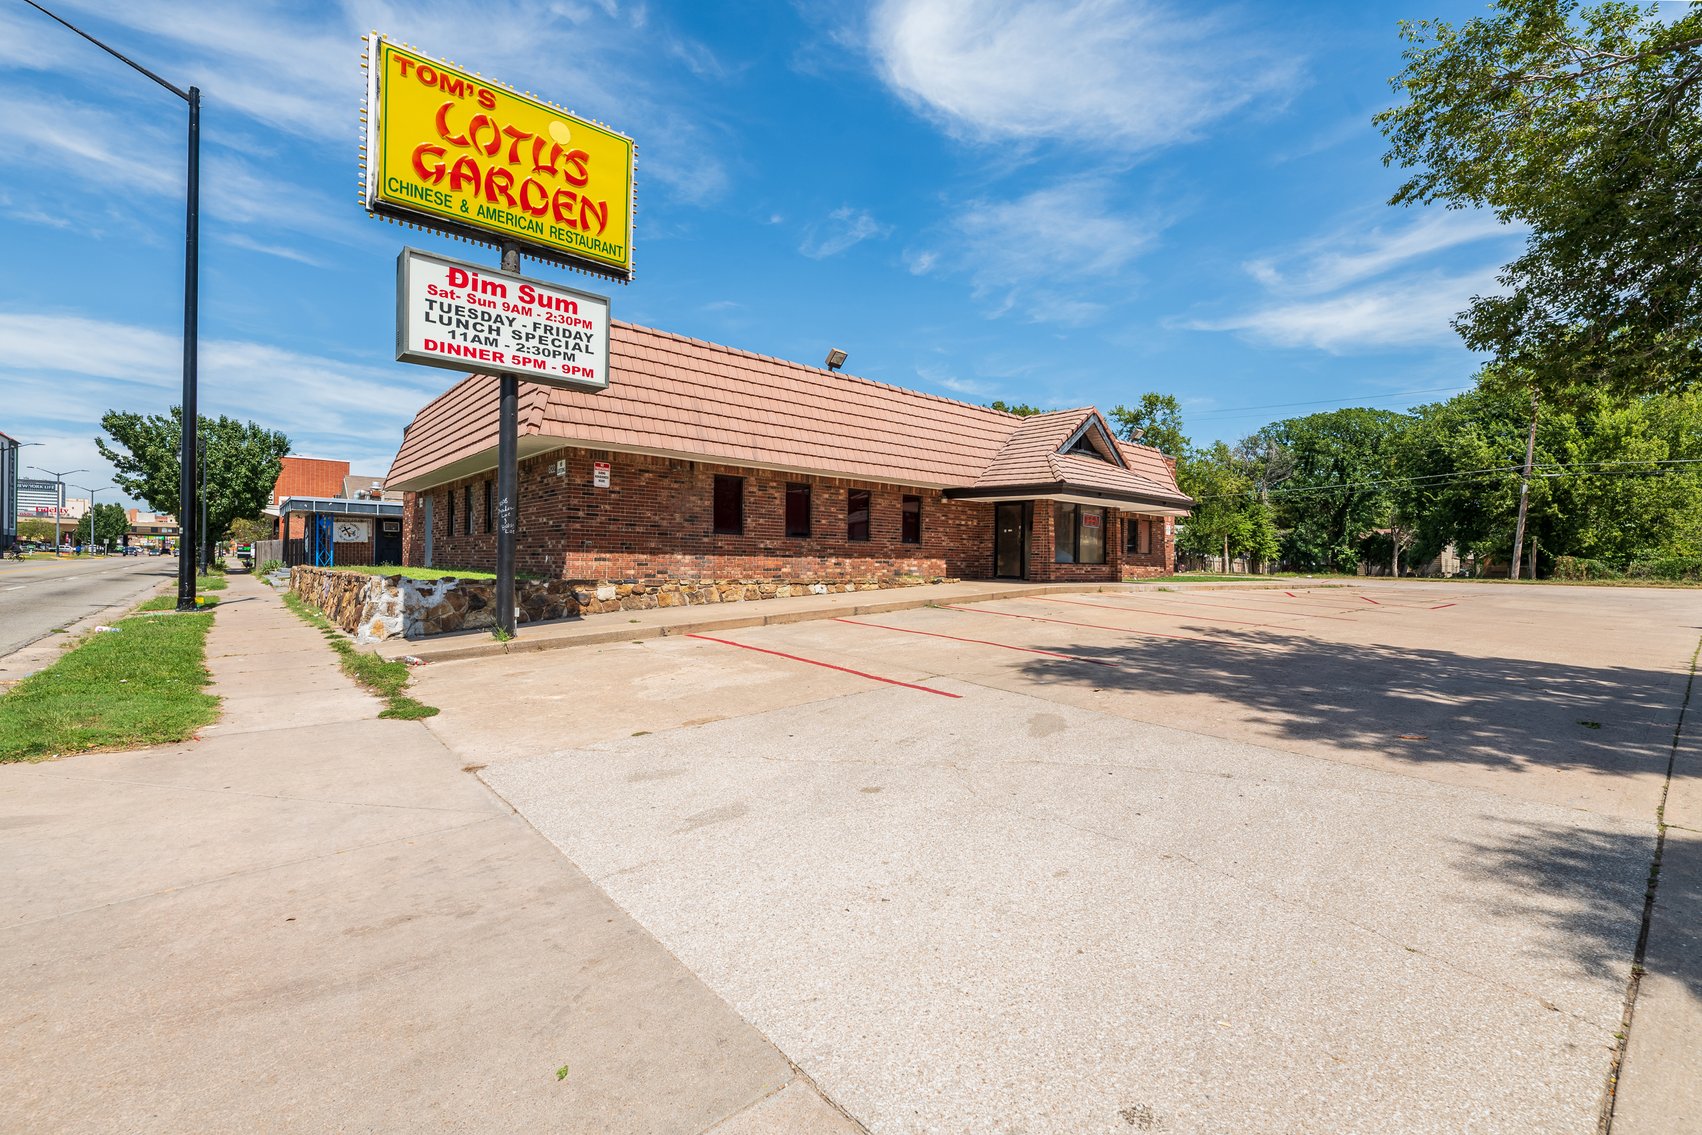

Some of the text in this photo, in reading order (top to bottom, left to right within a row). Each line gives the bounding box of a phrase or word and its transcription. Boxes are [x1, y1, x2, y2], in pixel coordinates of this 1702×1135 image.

[393, 54, 497, 110] TOM'S
[435, 101, 590, 188] LOTUS
[411, 142, 608, 237] GARDEN
[388, 177, 624, 259] CHINESE & AMERICAN RESTAURANT
[425, 298, 516, 328] TUESDAY
[533, 322, 594, 344] FRIDAY
[427, 284, 461, 300] Sat-
[466, 293, 497, 309] Sun
[502, 302, 533, 317] 9AM
[545, 311, 593, 330] 2:30PM
[518, 284, 578, 315] Sum
[425, 311, 595, 355] LUNCH SPECIAL
[448, 330, 499, 348] 11AM
[515, 342, 576, 363] 2:30PM
[424, 338, 505, 364] DINNER
[511, 354, 546, 370] 5PM
[561, 364, 594, 379] 9PM
